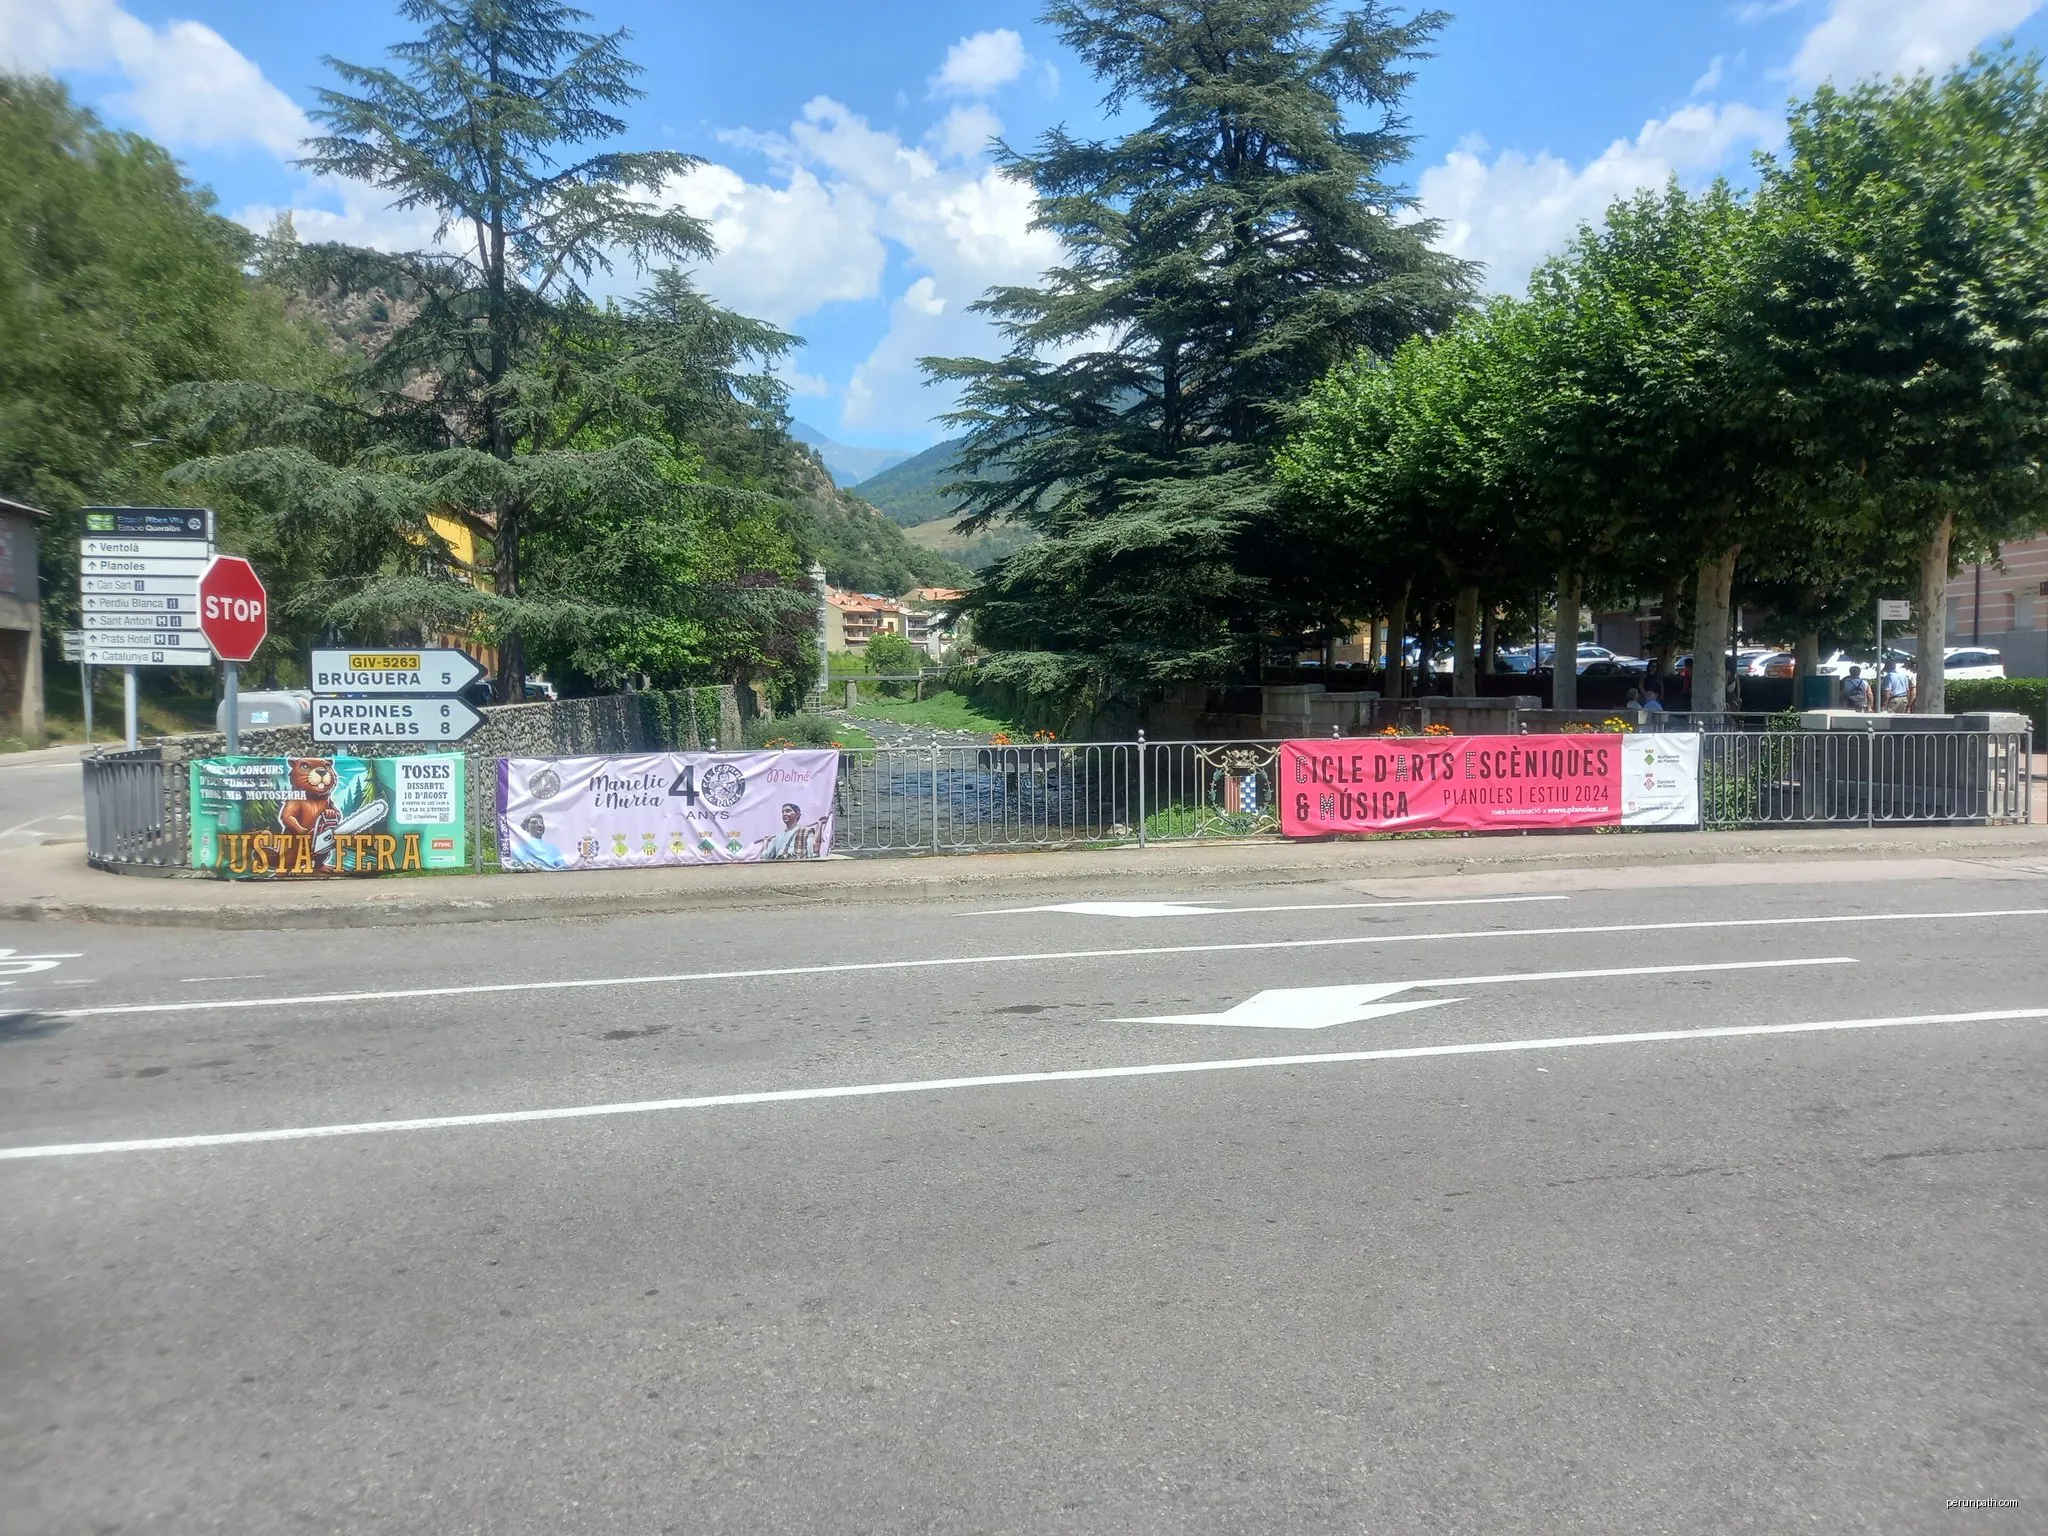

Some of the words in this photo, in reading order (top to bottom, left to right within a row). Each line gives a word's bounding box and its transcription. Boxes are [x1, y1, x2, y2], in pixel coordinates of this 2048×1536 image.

[145, 524, 181, 532] Queralbs
[100, 542, 139, 552] Ventolà
[100, 560, 145, 570] Planoles
[97, 580, 112, 590] Can
[115, 579, 131, 590] Sart
[100, 598, 129, 608] Perdiu
[132, 598, 163, 608] Blanca
[205, 595, 261, 622] STOP
[100, 615, 122, 625] Sant
[124, 616, 153, 625] Antoni
[101, 633, 125, 644] Prats
[128, 634, 151, 644] Hotel
[102, 651, 148, 663] Catalunya
[352, 657, 417, 668] GIV-5263
[318, 672, 421, 686] BRUGUERA
[441, 672, 451, 685] 5
[319, 705, 413, 718] PARDINES
[440, 705, 450, 717] 6
[319, 722, 419, 736] QUERALBS
[440, 722, 450, 734] 8
[1296, 755, 1363, 784] CICLE
[1374, 752, 1454, 782] D'ARTS
[1466, 746, 1608, 780] ESCÈNIQUES
[401, 764, 450, 779] TOSES
[766, 768, 810, 783] Moliné
[407, 782, 445, 790] DISSABTE
[589, 774, 670, 793] Manelic
[246, 790, 307, 800] MOTOSERRA
[606, 792, 664, 809] Núria
[1443, 787, 1513, 805] PLANOLES
[1529, 786, 1569, 803] ESTIU
[1575, 785, 1608, 801] 2024
[1296, 792, 1310, 821] &
[1320, 788, 1409, 820] MÚSICA
[1506, 807, 1541, 815] informació
[1547, 806, 1609, 815] www.planoles.cat
[686, 811, 729, 820] ANYS
[333, 833, 422, 873] FERA
